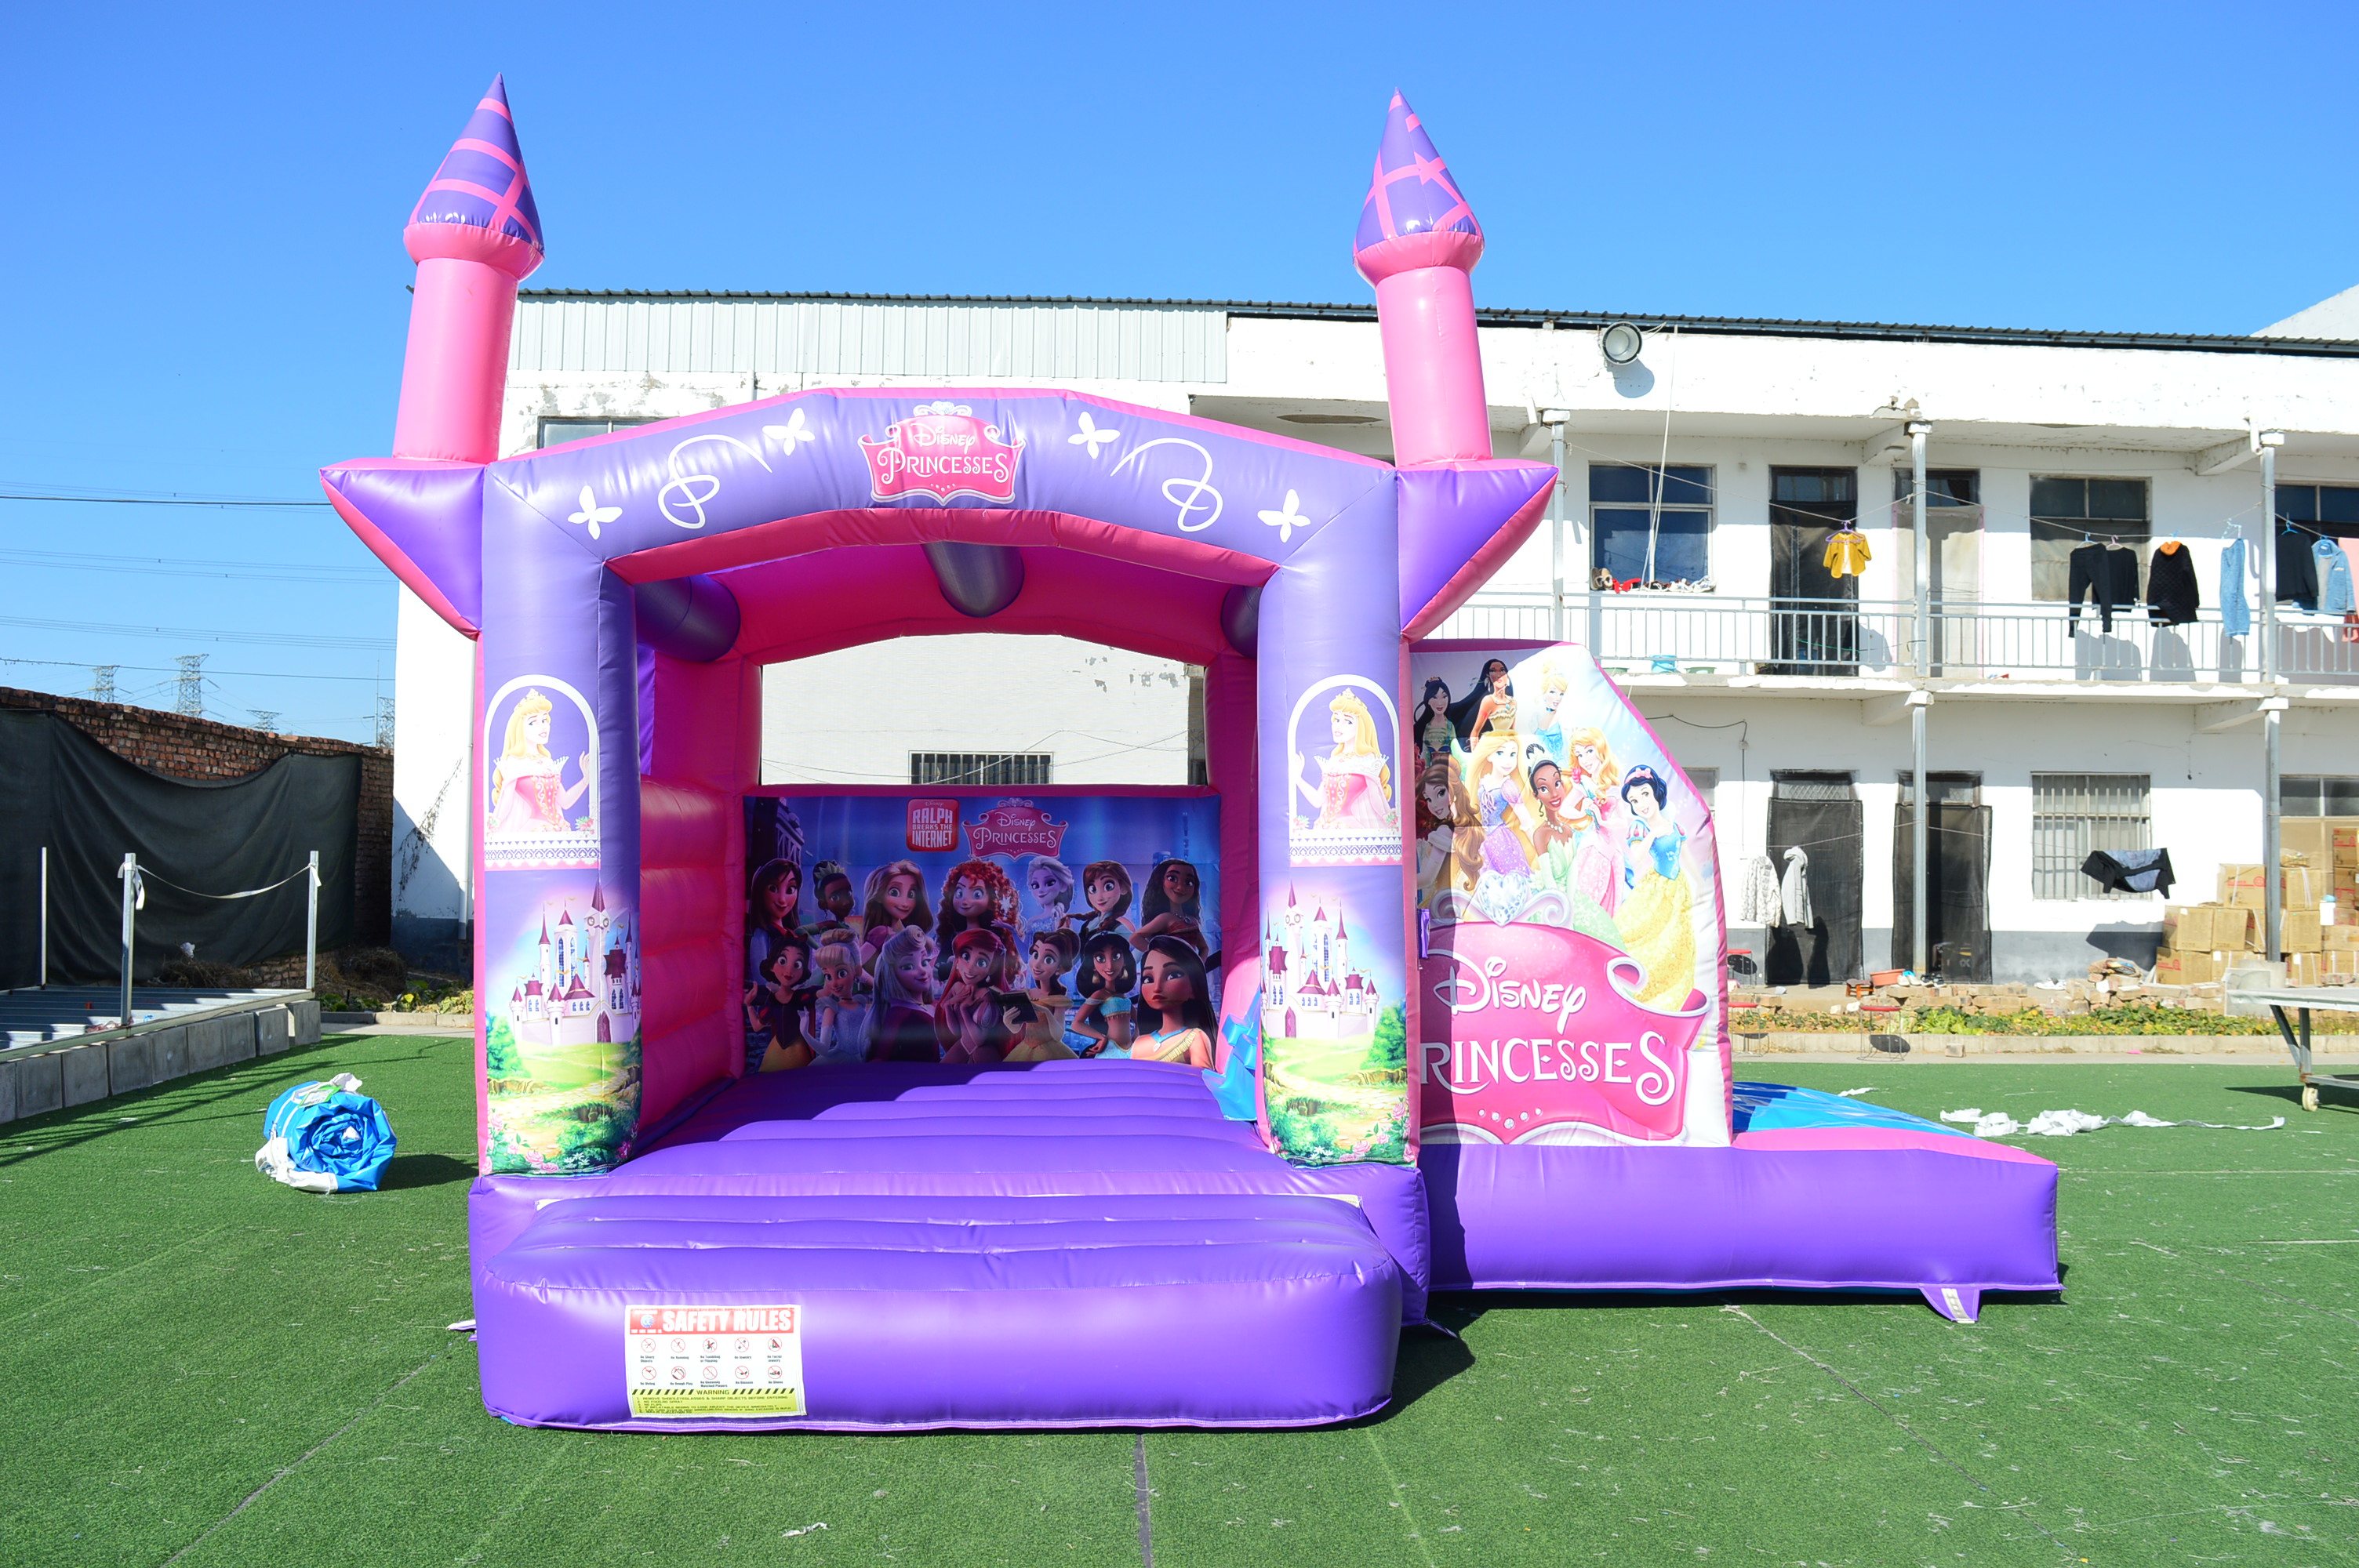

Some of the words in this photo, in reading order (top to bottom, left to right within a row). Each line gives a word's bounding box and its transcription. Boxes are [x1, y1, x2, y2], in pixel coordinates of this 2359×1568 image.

[877, 447, 1009, 485] PRINCESSES
[912, 808, 953, 824] RALPH
[912, 830, 953, 848] INTERNET
[972, 827, 1056, 850] PRINCESSES
[1420, 1030, 1676, 1106] RINCESSES
[662, 1309, 730, 1332] SAFETY
[733, 1309, 791, 1332] RULES
